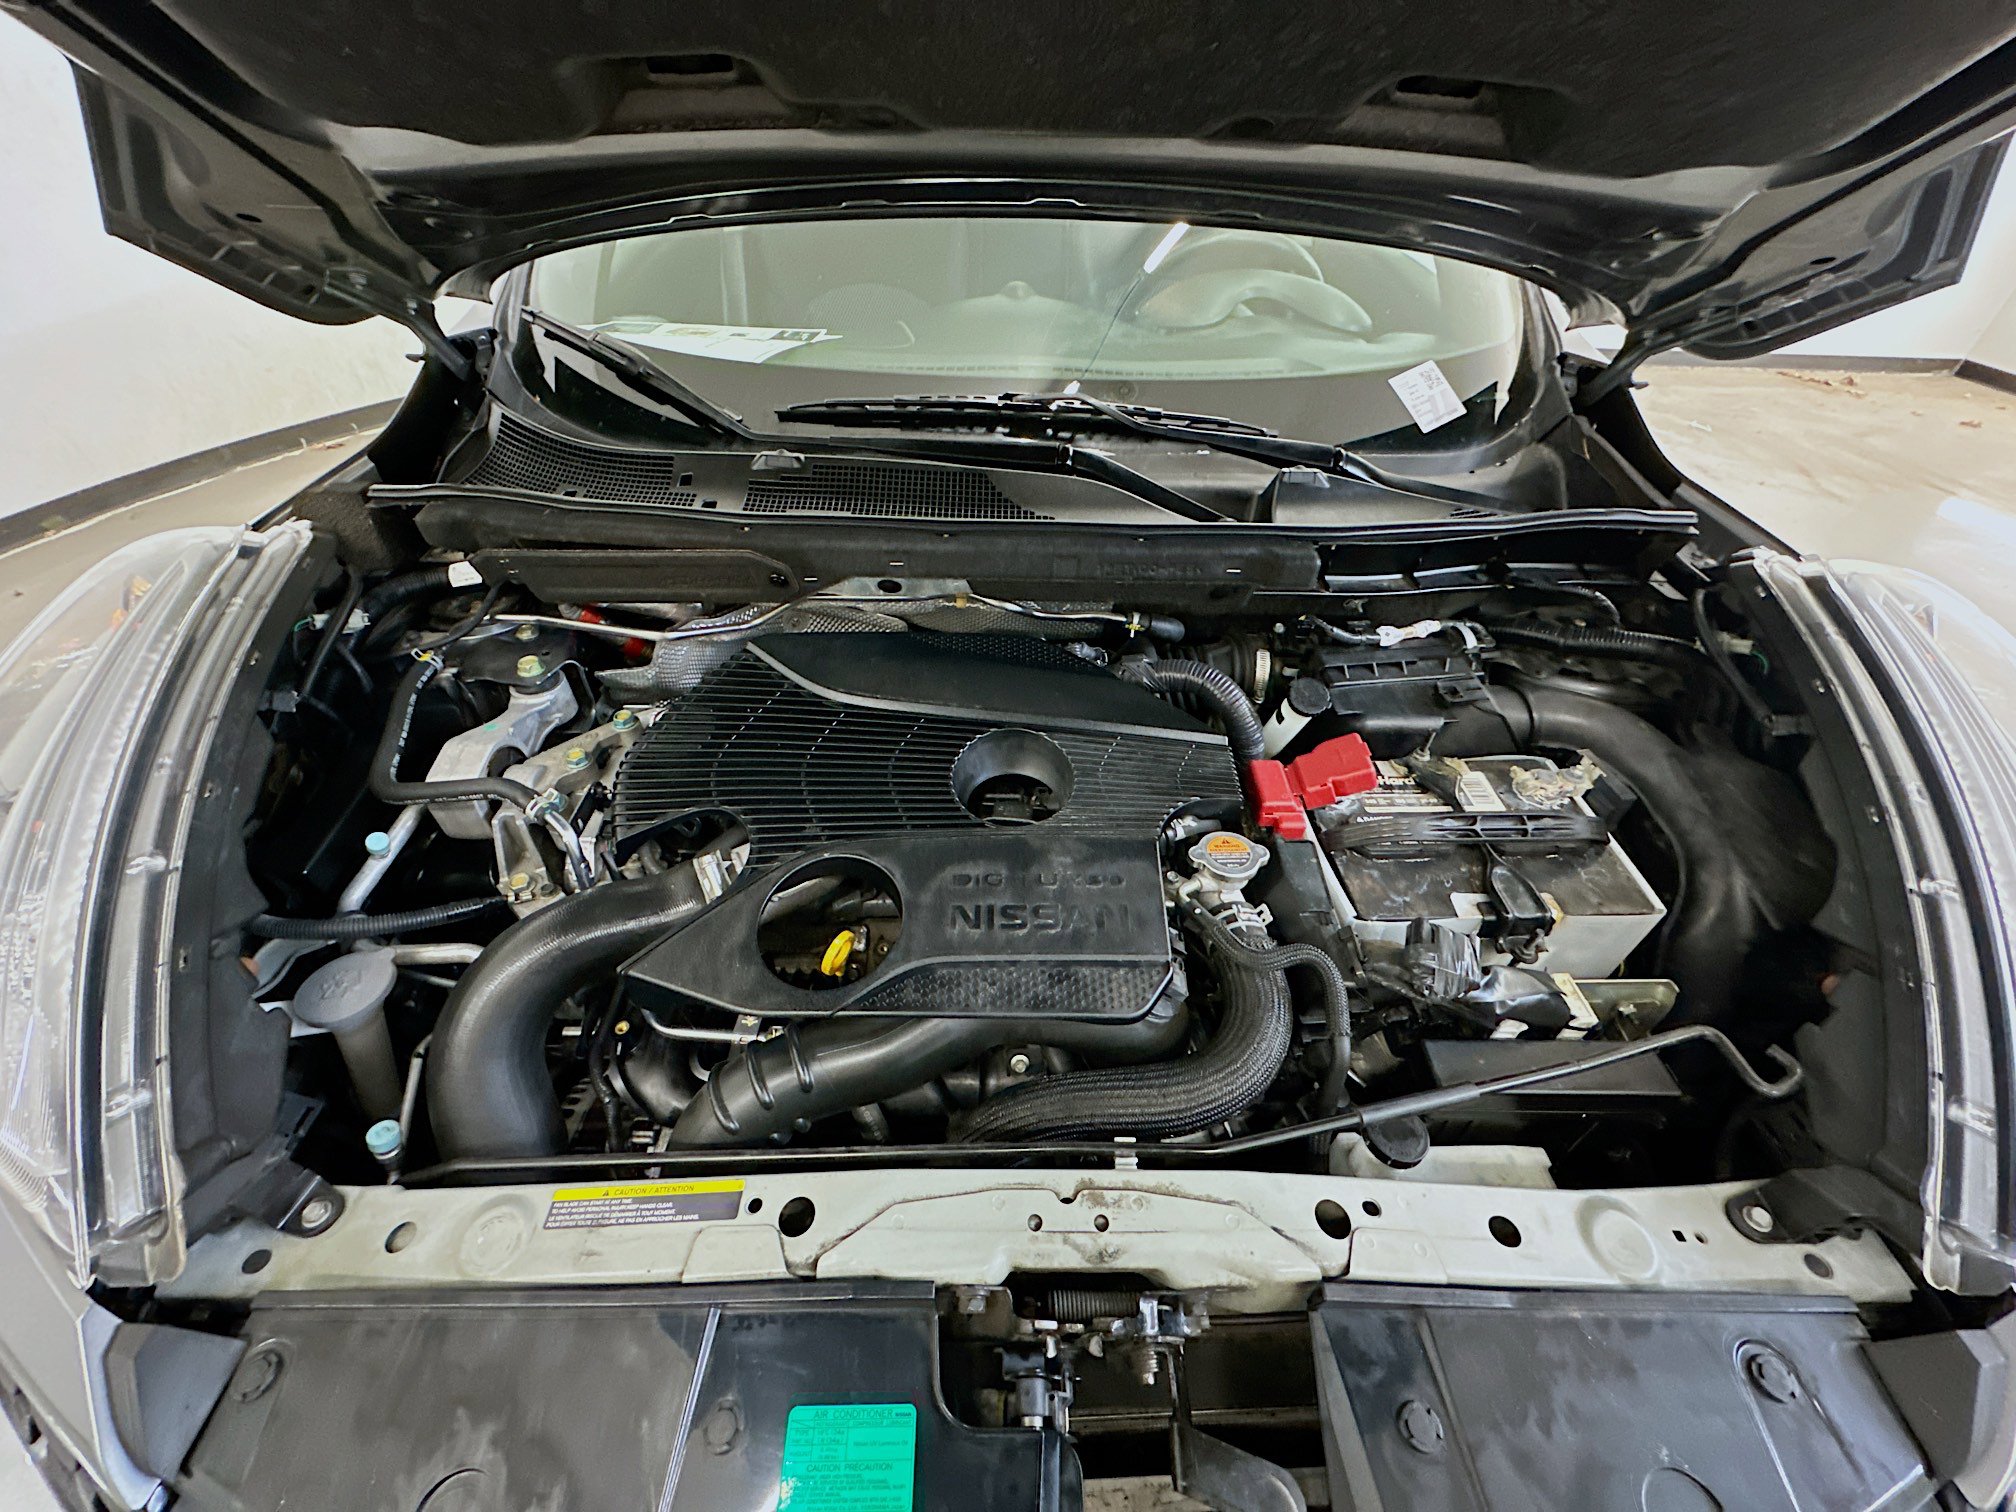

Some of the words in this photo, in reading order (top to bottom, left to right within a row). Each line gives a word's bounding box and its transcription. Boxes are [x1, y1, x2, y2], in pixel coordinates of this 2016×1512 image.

[950, 903, 1131, 931] NISSAN
[614, 1188, 647, 1196] CAUTION
[654, 1185, 694, 1194] ATTENTION
[814, 1409, 829, 1419] AIR
[833, 1409, 894, 1419] CONDITIONER
[807, 1463, 840, 1472] CAUTION
